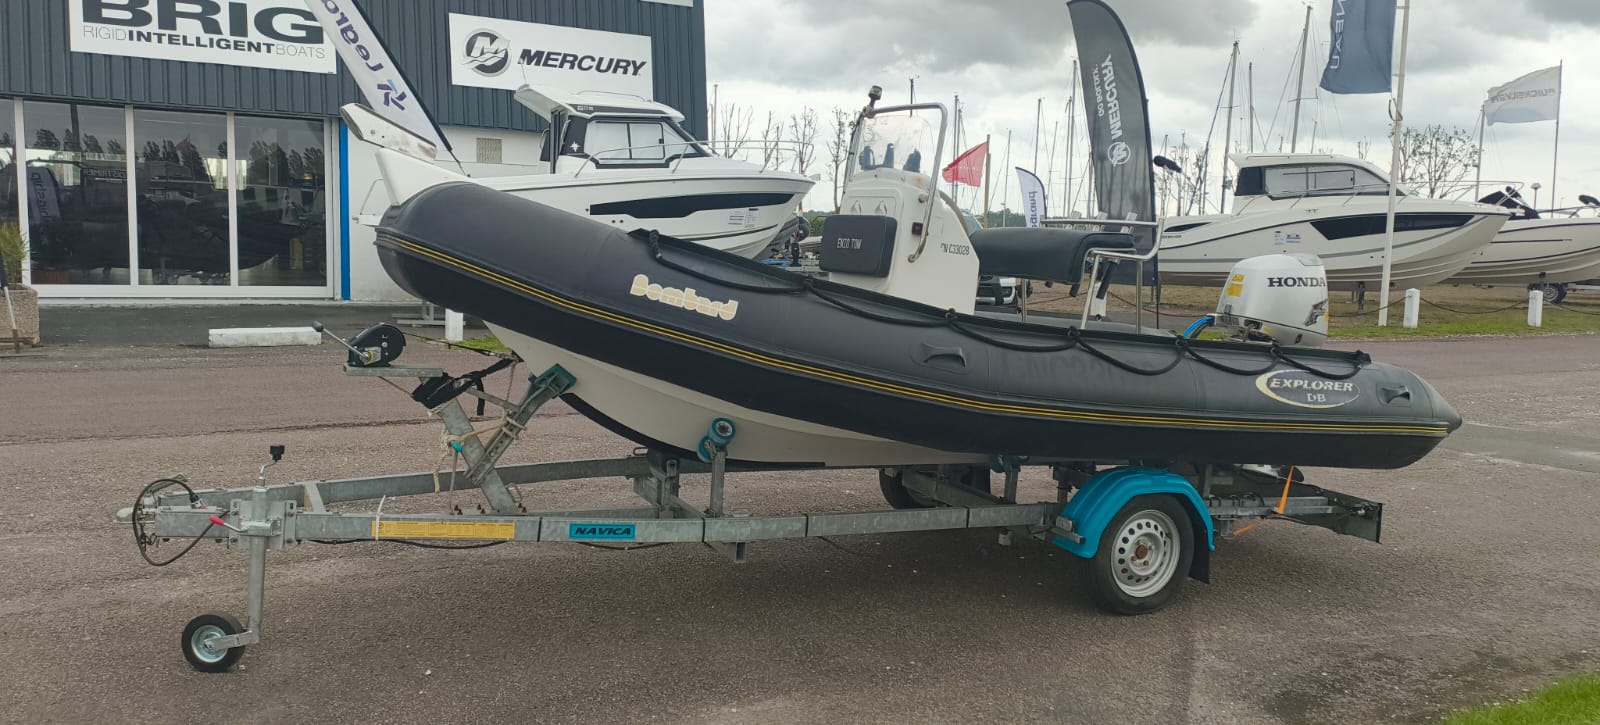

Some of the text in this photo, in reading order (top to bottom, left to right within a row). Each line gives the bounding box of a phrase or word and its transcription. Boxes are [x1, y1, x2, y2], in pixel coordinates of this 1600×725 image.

[83, 0, 324, 44] BRIG
[517, 48, 647, 76] MERCURY
[1267, 277, 1327, 288] HONDA
[630, 274, 738, 320] Bombard
[1269, 378, 1353, 392] EXPLORER
[1306, 393, 1327, 403] DB
[575, 527, 631, 536] NAVICA
